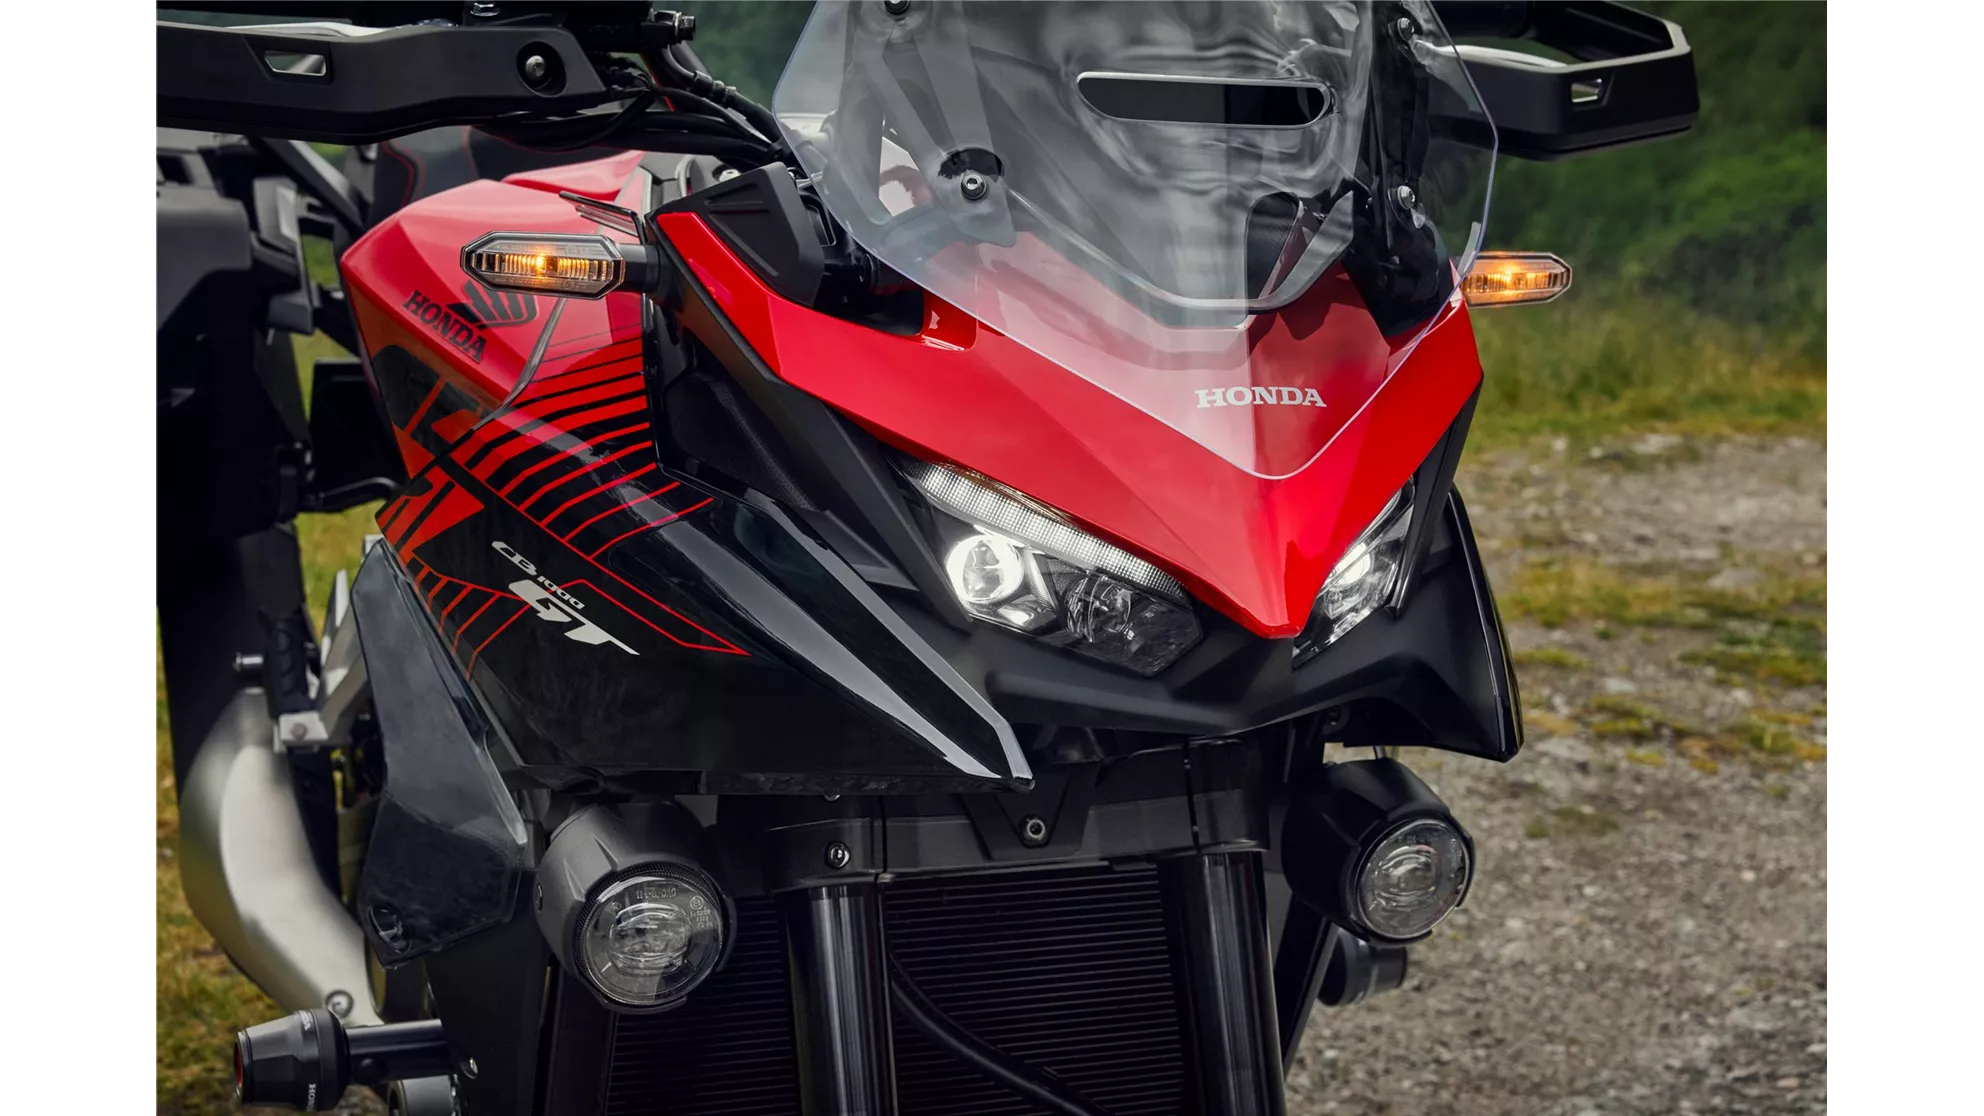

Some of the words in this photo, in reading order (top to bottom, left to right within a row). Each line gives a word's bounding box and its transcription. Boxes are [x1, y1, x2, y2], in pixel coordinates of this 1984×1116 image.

[403, 290, 487, 365] HONDA
[1195, 386, 1327, 408] HONDA
[508, 579, 640, 655] GT
